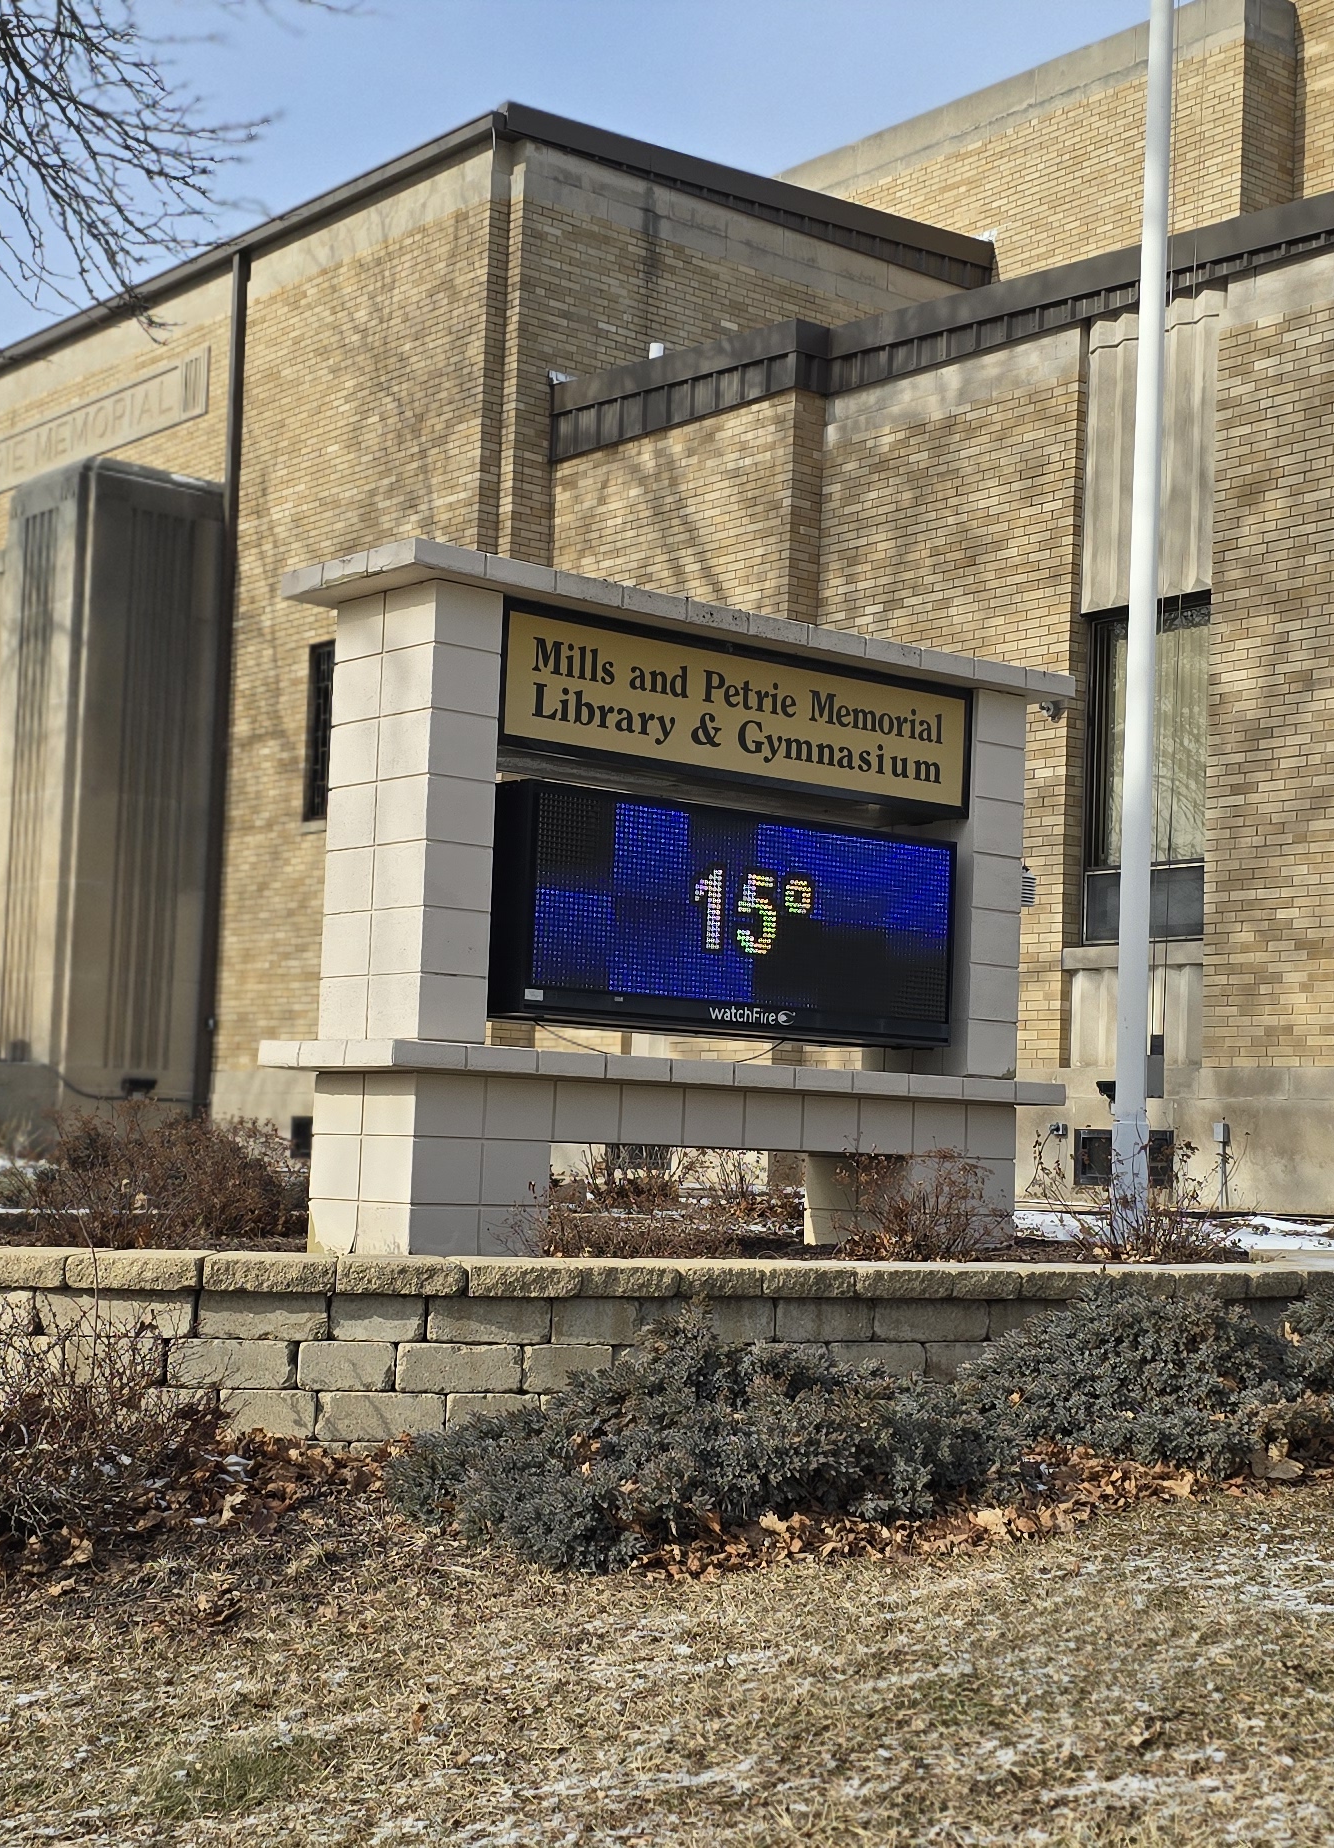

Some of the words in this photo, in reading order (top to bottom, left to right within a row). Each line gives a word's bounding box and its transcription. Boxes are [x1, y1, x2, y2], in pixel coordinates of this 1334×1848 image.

[35, 379, 174, 466] MEMORIAL
[531, 636, 616, 686] Mills
[629, 665, 690, 699] and
[702, 669, 797, 718] Petrie
[808, 689, 943, 745] Memorial
[531, 682, 676, 746] Library
[690, 712, 723, 748] &
[737, 719, 942, 785] Gymnasium
